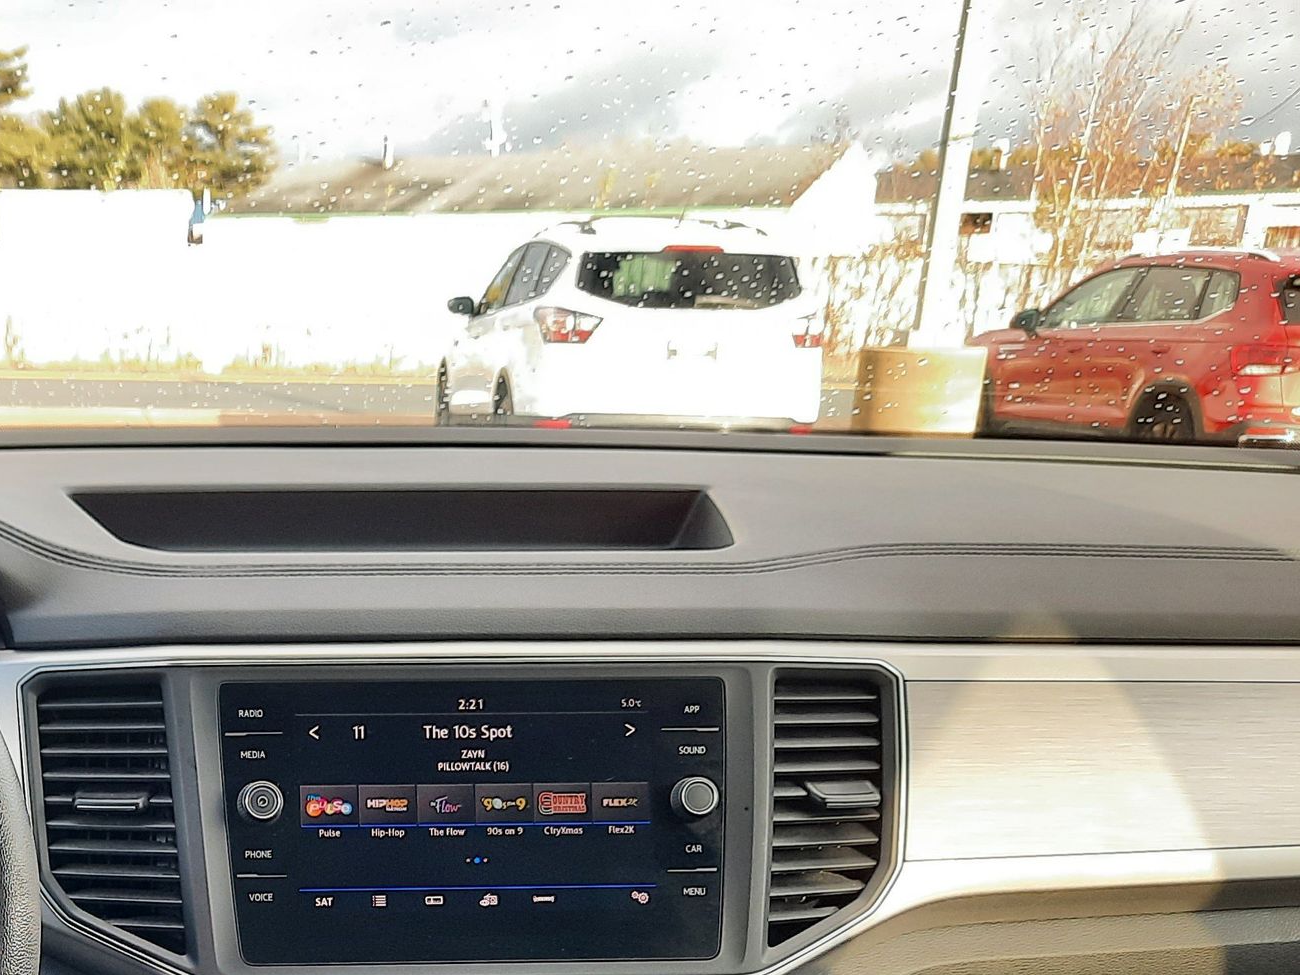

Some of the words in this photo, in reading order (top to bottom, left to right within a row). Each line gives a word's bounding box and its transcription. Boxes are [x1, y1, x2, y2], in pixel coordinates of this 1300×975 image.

[458, 699, 483, 710] 2:21
[684, 704, 699, 713] APP
[238, 709, 263, 718] RADIO
[353, 725, 365, 740] 11
[423, 725, 448, 739] The
[453, 725, 476, 739] 10s
[481, 725, 513, 742] Spot
[240, 750, 266, 759] MEDIA
[461, 750, 484, 759] ZAYN
[678, 745, 706, 755] SOUND
[438, 761, 491, 771] PILLOWTALK
[493, 761, 510, 773] (16)
[319, 828, 341, 838] Pulse
[371, 828, 405, 840] Hip-Hop
[429, 828, 444, 837] The
[446, 827, 466, 837] Flow
[487, 827, 503, 836] 90s
[518, 827, 523, 836] 9
[608, 825, 635, 835] Flex2K
[685, 844, 702, 853] CAR
[245, 850, 272, 859] PHONE
[683, 887, 706, 896] MENU
[249, 893, 273, 902] VOICE
[315, 897, 333, 906] SAT
